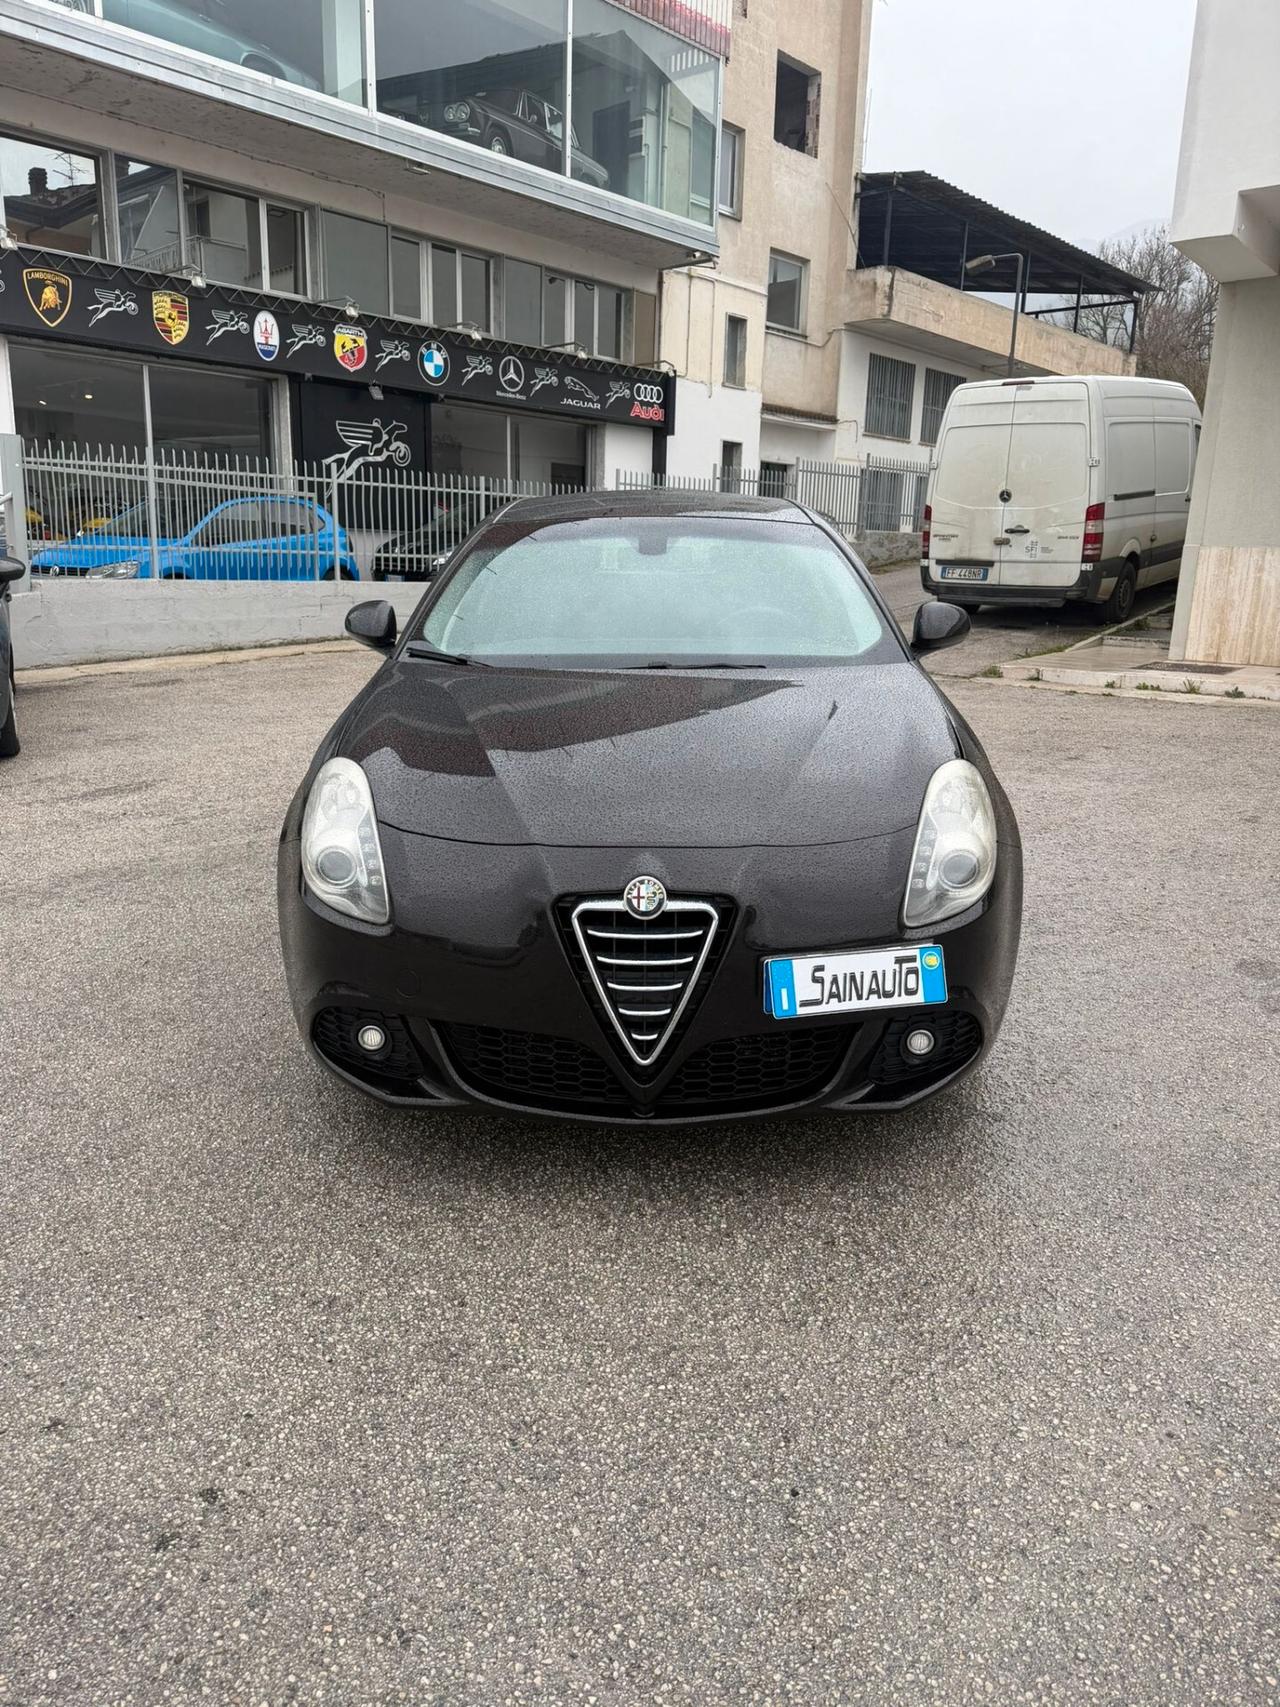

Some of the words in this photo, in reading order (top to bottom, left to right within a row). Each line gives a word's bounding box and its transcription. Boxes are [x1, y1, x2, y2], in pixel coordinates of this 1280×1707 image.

[27, 271, 69, 287] LAMBORGHINI
[421, 342, 448, 359] BMW
[560, 398, 601, 410] JAGUAR
[630, 401, 665, 421] Audi
[799, 954, 920, 1008] SAINAUTO
